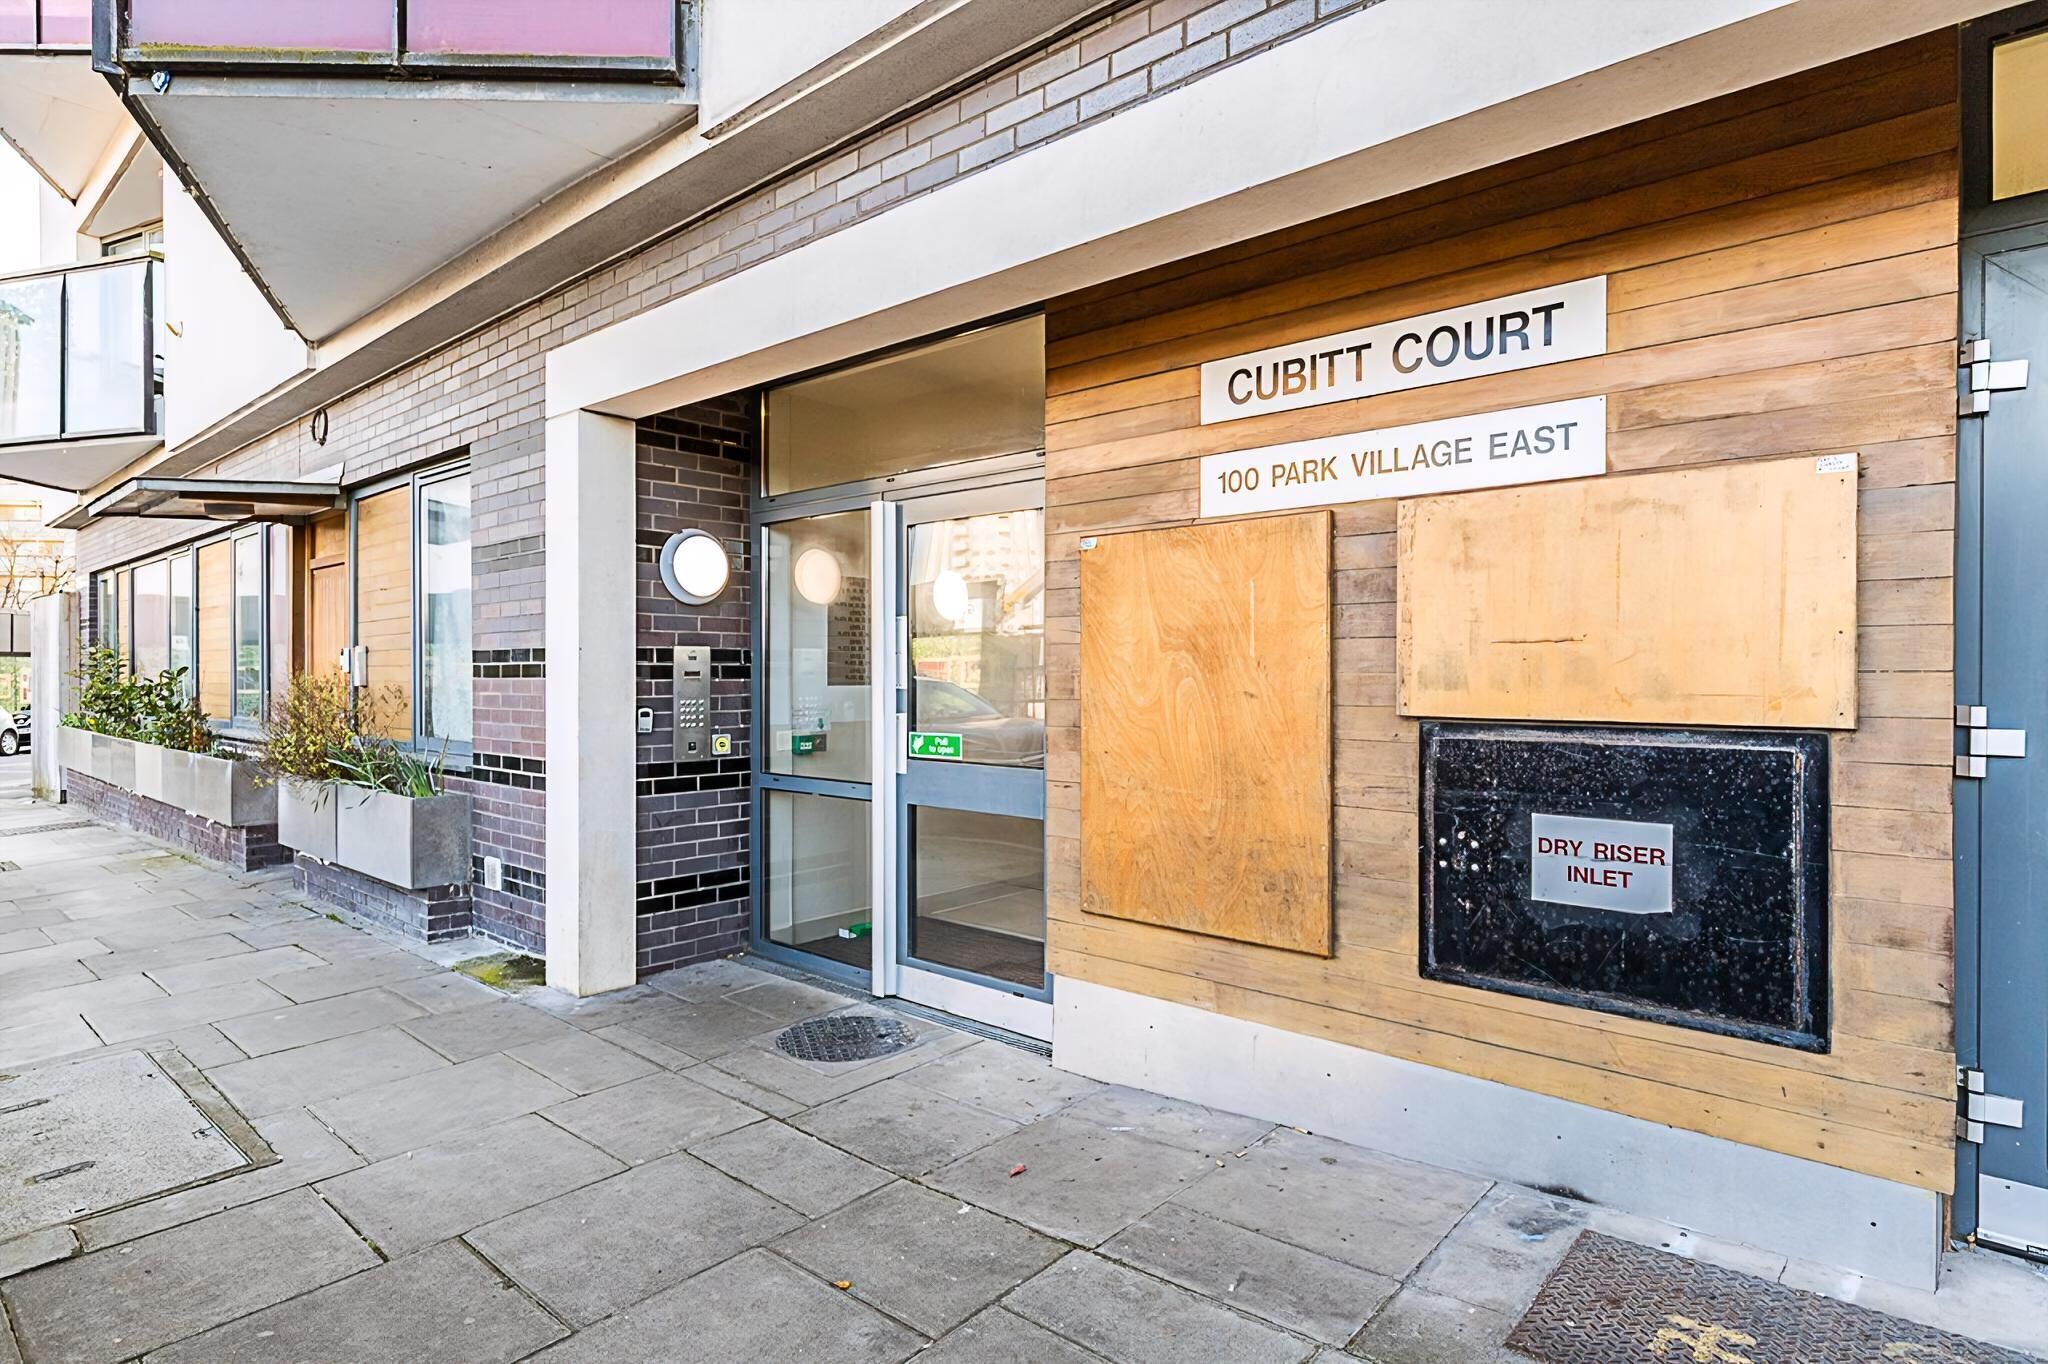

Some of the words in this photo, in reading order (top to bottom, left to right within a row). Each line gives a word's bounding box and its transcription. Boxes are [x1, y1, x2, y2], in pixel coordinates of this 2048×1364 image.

[1227, 342, 1372, 405] CUBITT
[1392, 301, 1565, 374] COURT
[1217, 467, 1259, 494] 100
[1271, 456, 1338, 488] PARK
[1351, 437, 1473, 477] VILLAGE
[1489, 421, 1578, 460] EAST
[1538, 837, 1583, 857] DRY
[1594, 842, 1666, 866] RISER
[1567, 865, 1633, 889] INLET
